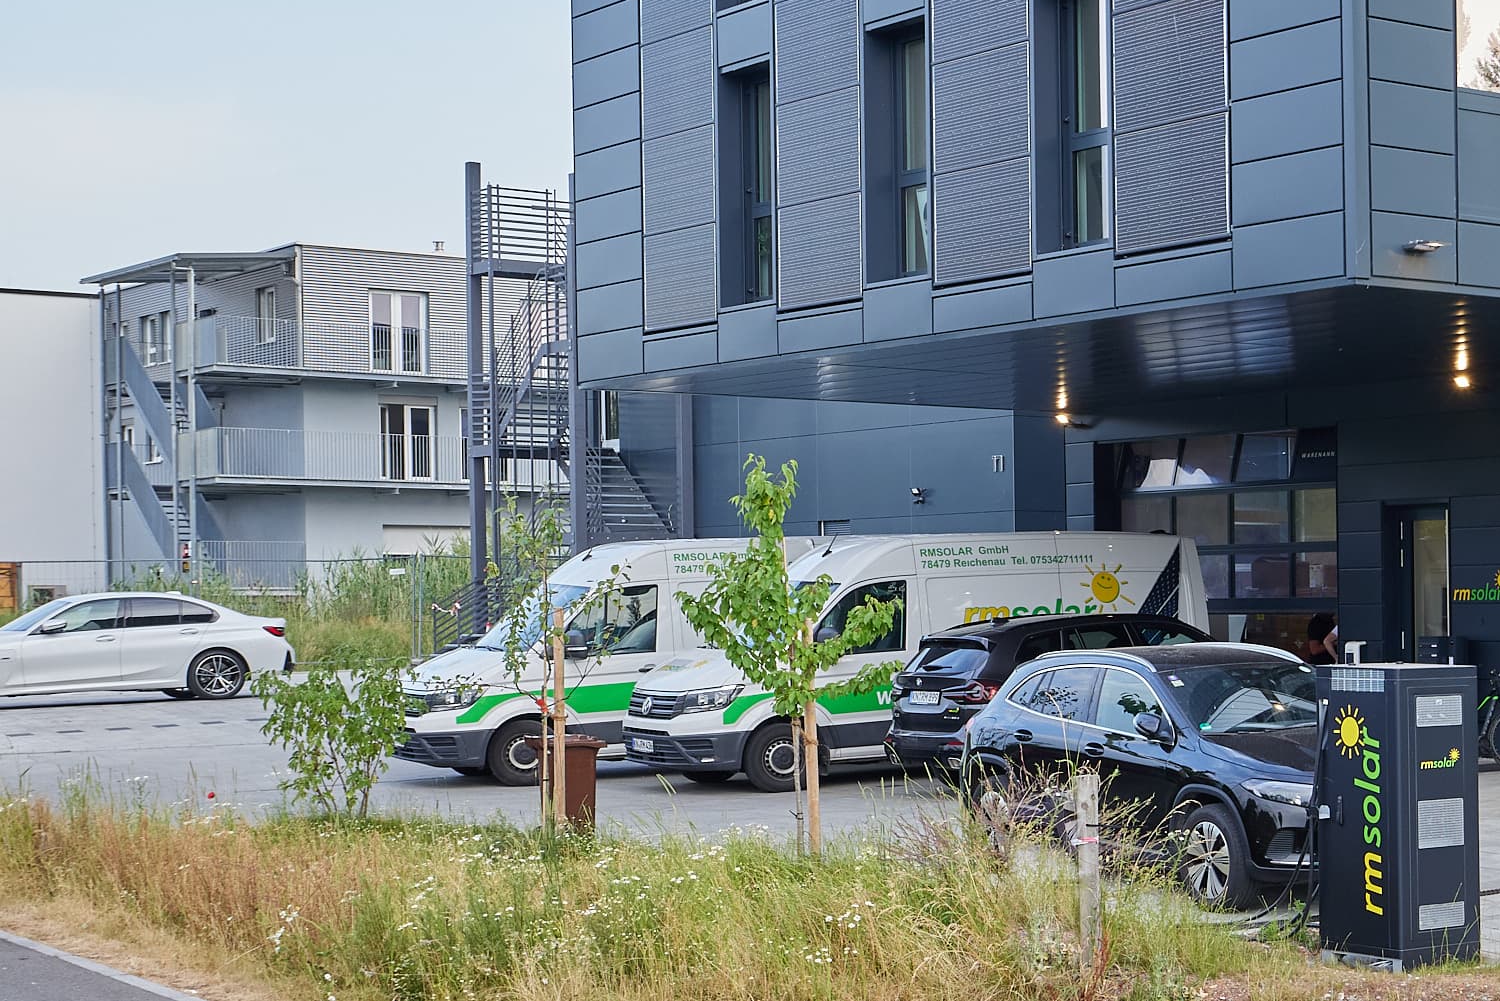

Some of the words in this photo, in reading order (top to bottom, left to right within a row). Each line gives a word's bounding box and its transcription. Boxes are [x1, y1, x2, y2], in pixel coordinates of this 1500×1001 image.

[919, 546, 973, 557] RMSOLAR
[978, 545, 1009, 555] GmbH
[674, 564, 704, 574] 78479
[921, 559, 951, 569] 78479
[953, 558, 1006, 568] Reichenau
[1011, 556, 1028, 565] Tel.
[1420, 756, 1457, 769] rmsolar
[1353, 726, 1384, 916] rmsolar
